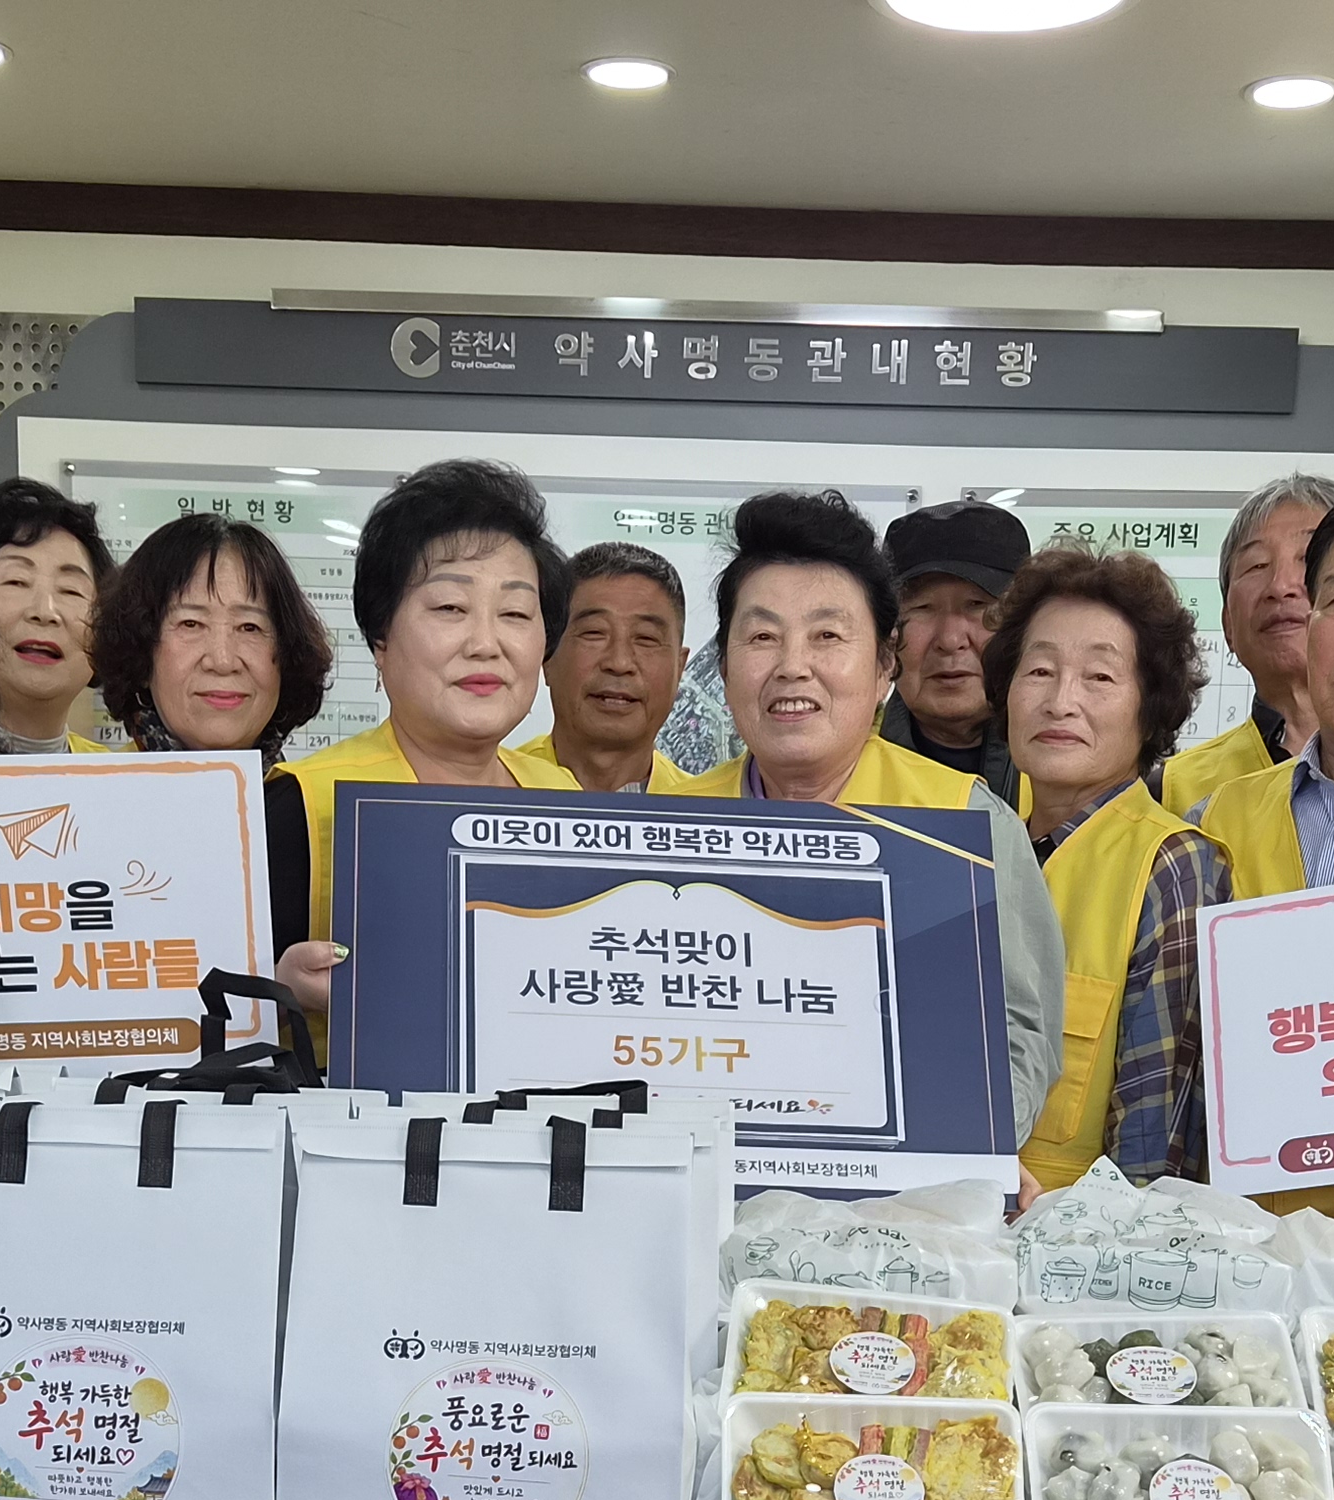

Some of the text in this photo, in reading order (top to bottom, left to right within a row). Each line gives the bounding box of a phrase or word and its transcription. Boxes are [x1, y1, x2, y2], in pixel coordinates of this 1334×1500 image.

[449, 329, 516, 358] 춘천시
[1050, 521, 1200, 549] 주요 사업계획
[309, 735, 331, 748] 237
[470, 817, 863, 862] 이웃이 있어 행복한 약사명동
[587, 925, 754, 967] 추석맞이
[53, 937, 201, 991] 사람들
[518, 966, 838, 1016] 사랑愛 반찬 나눔
[31, 1026, 180, 1049] 지역사회보장협의체
[611, 1033, 752, 1076] 55가구
[1138, 1276, 1172, 1291] RICE
